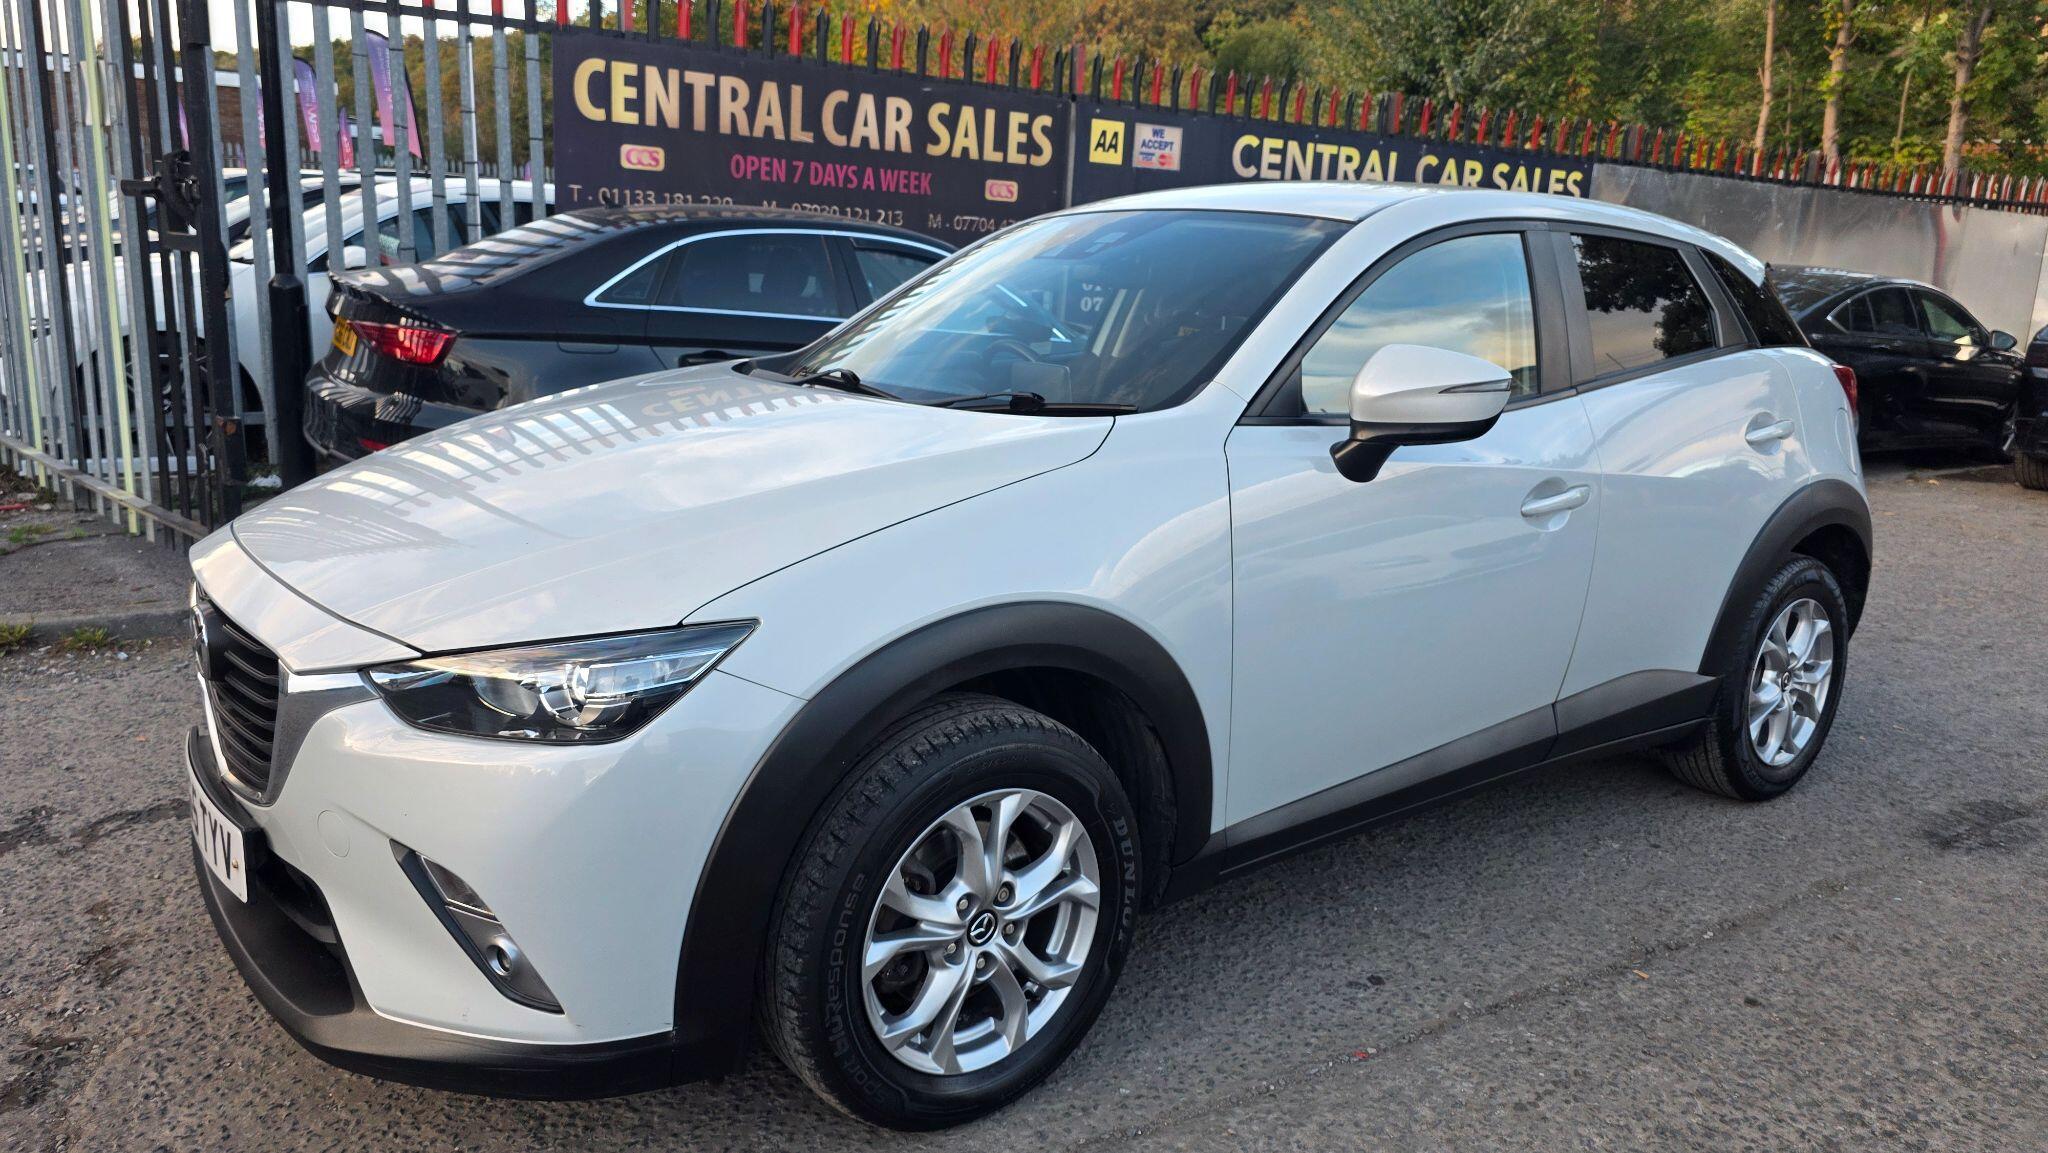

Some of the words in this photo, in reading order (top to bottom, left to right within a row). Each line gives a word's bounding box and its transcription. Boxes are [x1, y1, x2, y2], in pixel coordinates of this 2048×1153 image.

[573, 57, 814, 143] CENTRAL
[821, 89, 912, 153] CAR
[926, 102, 1053, 167] SALES
[1094, 130, 1119, 153] AA
[1141, 139, 1174, 151] ACCEPT
[1152, 128, 1165, 139] WE
[625, 147, 660, 167] CCS
[731, 154, 787, 183] OPEN
[792, 160, 804, 183] 7
[810, 161, 858, 189] DAYS
[862, 167, 875, 191] A
[880, 168, 932, 195] WEEK
[1113, 816, 1136, 942] DUNLO
